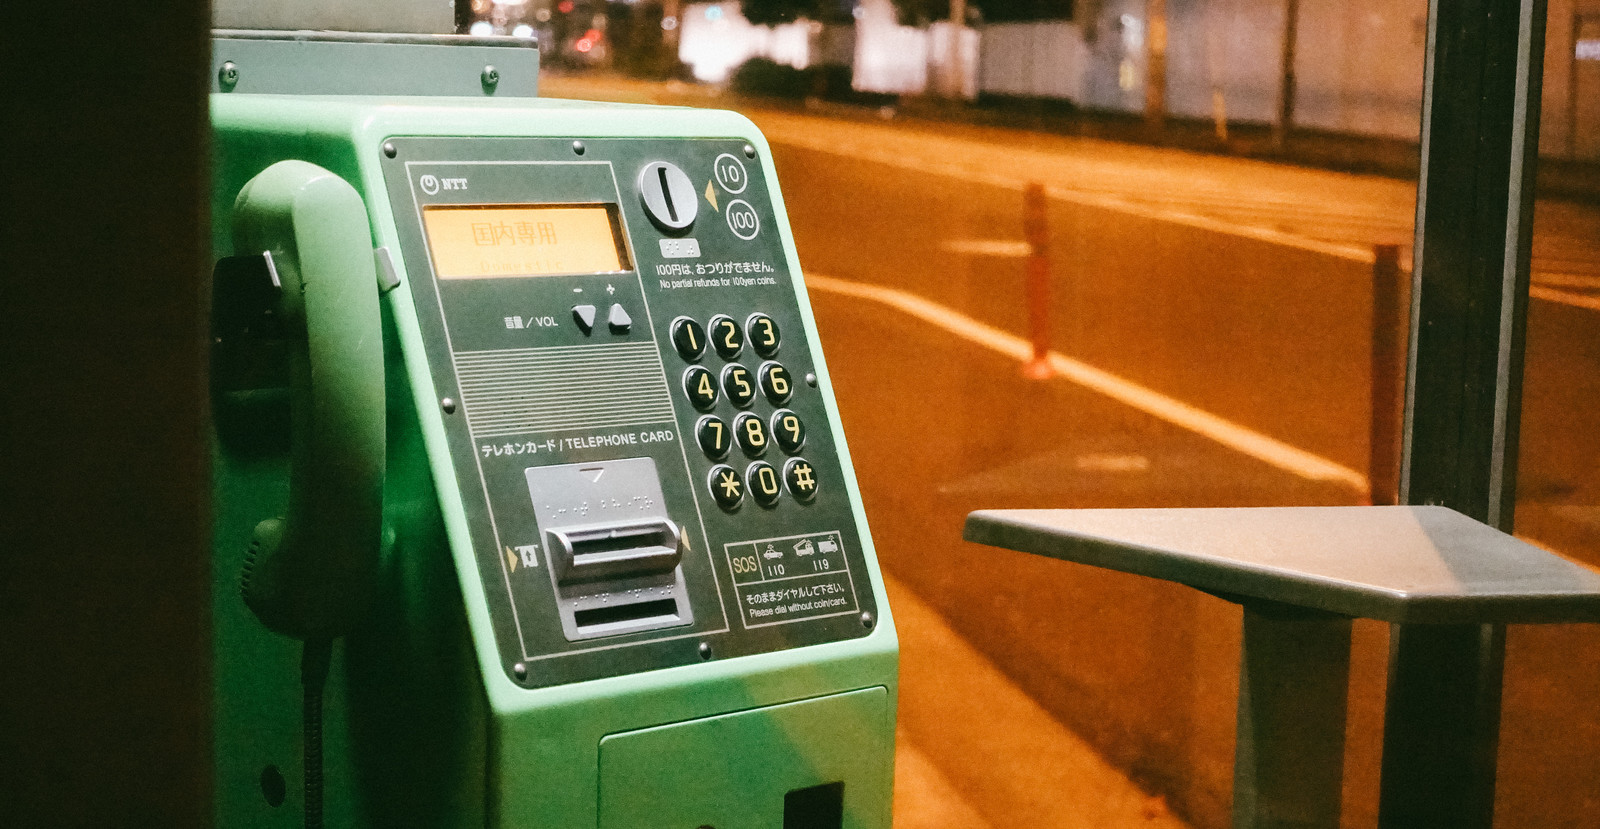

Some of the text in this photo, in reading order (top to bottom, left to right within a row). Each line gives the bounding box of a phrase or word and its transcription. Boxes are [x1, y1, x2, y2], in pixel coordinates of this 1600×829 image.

[441, 178, 468, 190] NTT
[721, 165, 740, 183] 10
[731, 212, 754, 229] 100
[471, 220, 558, 246] 国内専用
[480, 259, 565, 273] Domestic
[660, 279, 670, 289] No
[671, 278, 693, 290] partial
[694, 278, 720, 288] refunds
[720, 277, 730, 286] for
[686, 318, 775, 350] 1 2 3
[698, 367, 789, 399] 4 5 6
[708, 415, 800, 450] 7 8 9
[481, 439, 556, 458] テレホンカード
[565, 433, 637, 450] TELEPHONE
[640, 430, 674, 444] CARD
[758, 467, 778, 495] 0
[732, 555, 829, 577] SOS 110 119
[749, 608, 774, 618] Please
[775, 604, 788, 615] dial
[788, 601, 814, 613] without
